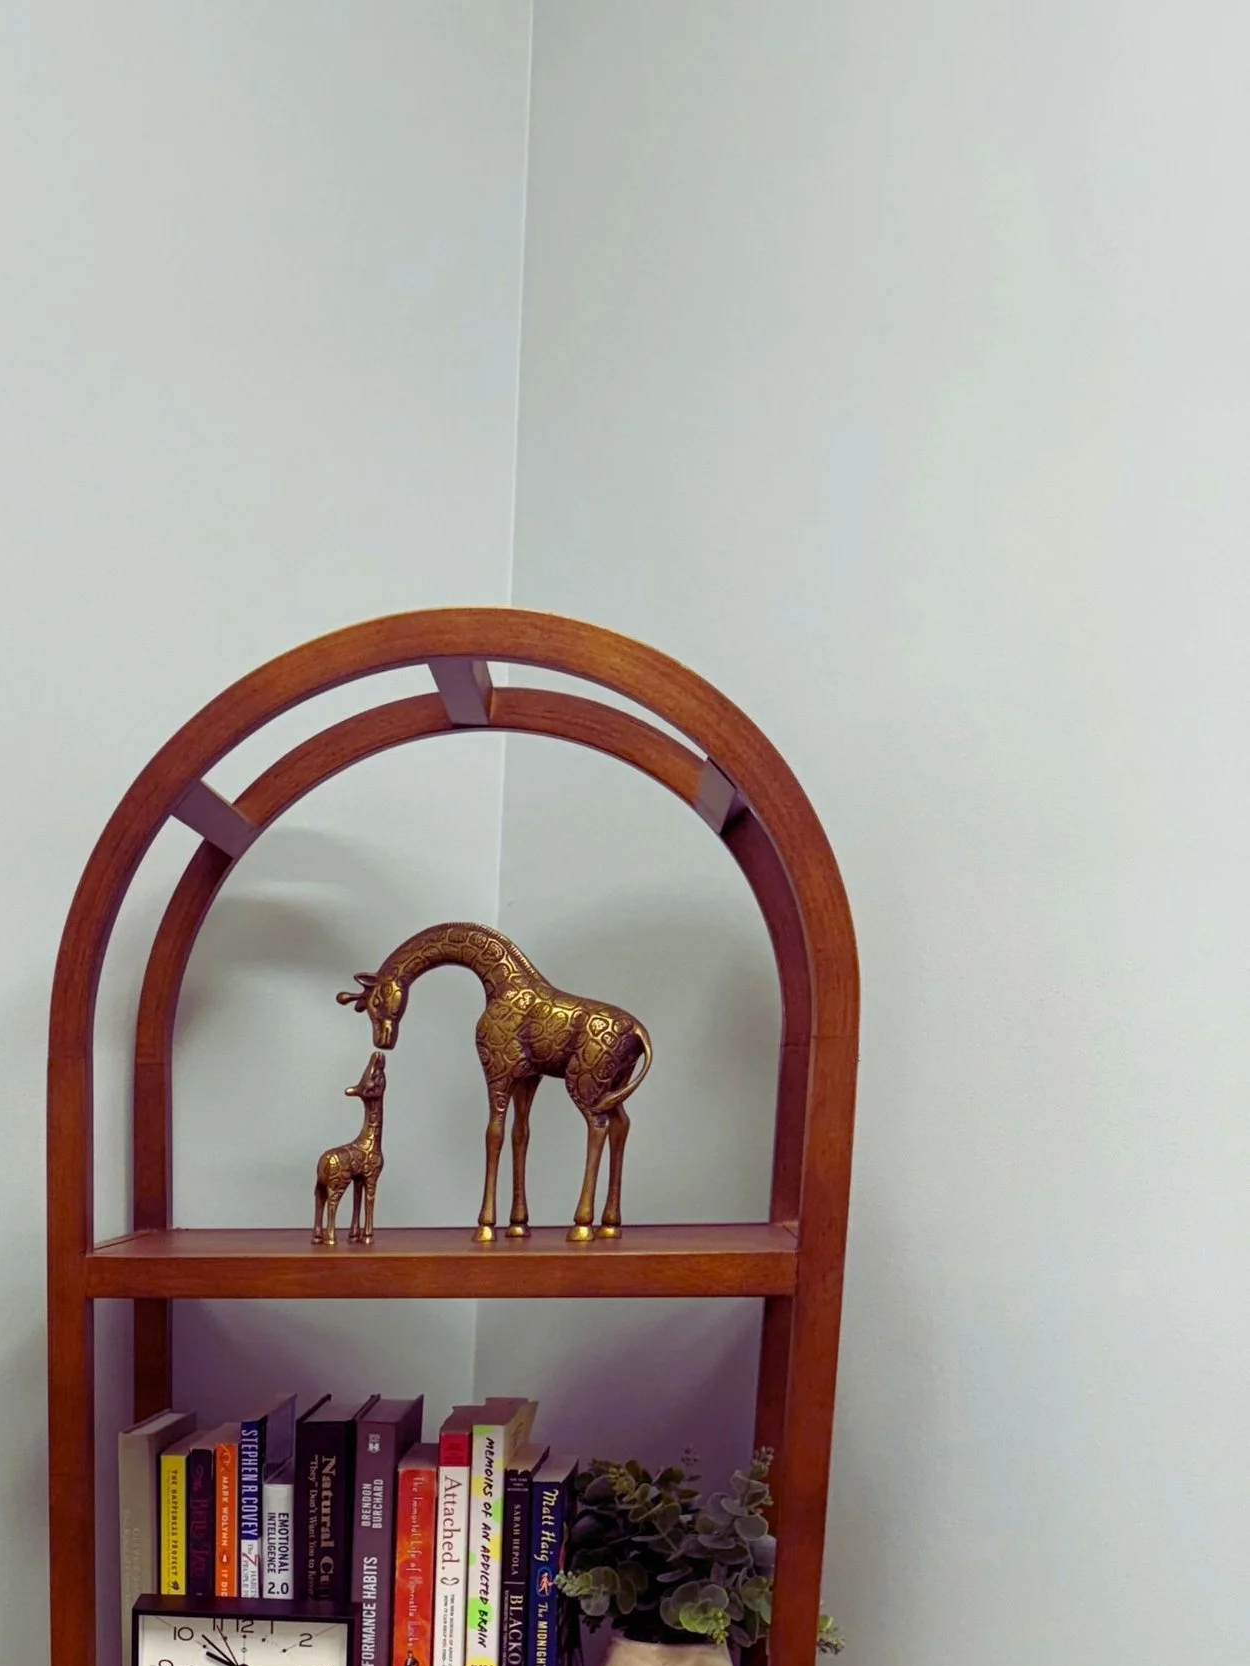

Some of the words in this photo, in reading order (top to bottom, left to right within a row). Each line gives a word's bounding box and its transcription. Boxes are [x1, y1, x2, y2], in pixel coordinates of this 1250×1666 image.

[241, 1429, 258, 1483] STEPHEN
[482, 1437, 495, 1498] MEMOIRS
[241, 1497, 258, 1536] COVEY
[320, 1456, 336, 1548] Natural
[361, 1483, 372, 1527] BRENDON
[372, 1478, 384, 1528] BURCHARD
[481, 1502, 492, 1518] OF
[513, 1504, 521, 1536] SARAH
[542, 1489, 559, 1526] Matt
[442, 1476, 463, 1570] Attached.
[481, 1523, 492, 1541] AN
[267, 1512, 276, 1574] INTELLIGENCE
[278, 1512, 290, 1574] EMOTIONAL
[511, 1538, 520, 1576] HEPOLA
[534, 1530, 557, 1562] Haig
[267, 1582, 290, 1595] 2.0
[362, 1556, 378, 1600] HABITS
[478, 1546, 492, 1605] ADDICTED
[236, 1619, 254, 1633] 12
[477, 1610, 489, 1648] BRAIN
[538, 1603, 548, 1618] The
[174, 1626, 194, 1640] 10
[299, 1633, 313, 1647] 2
